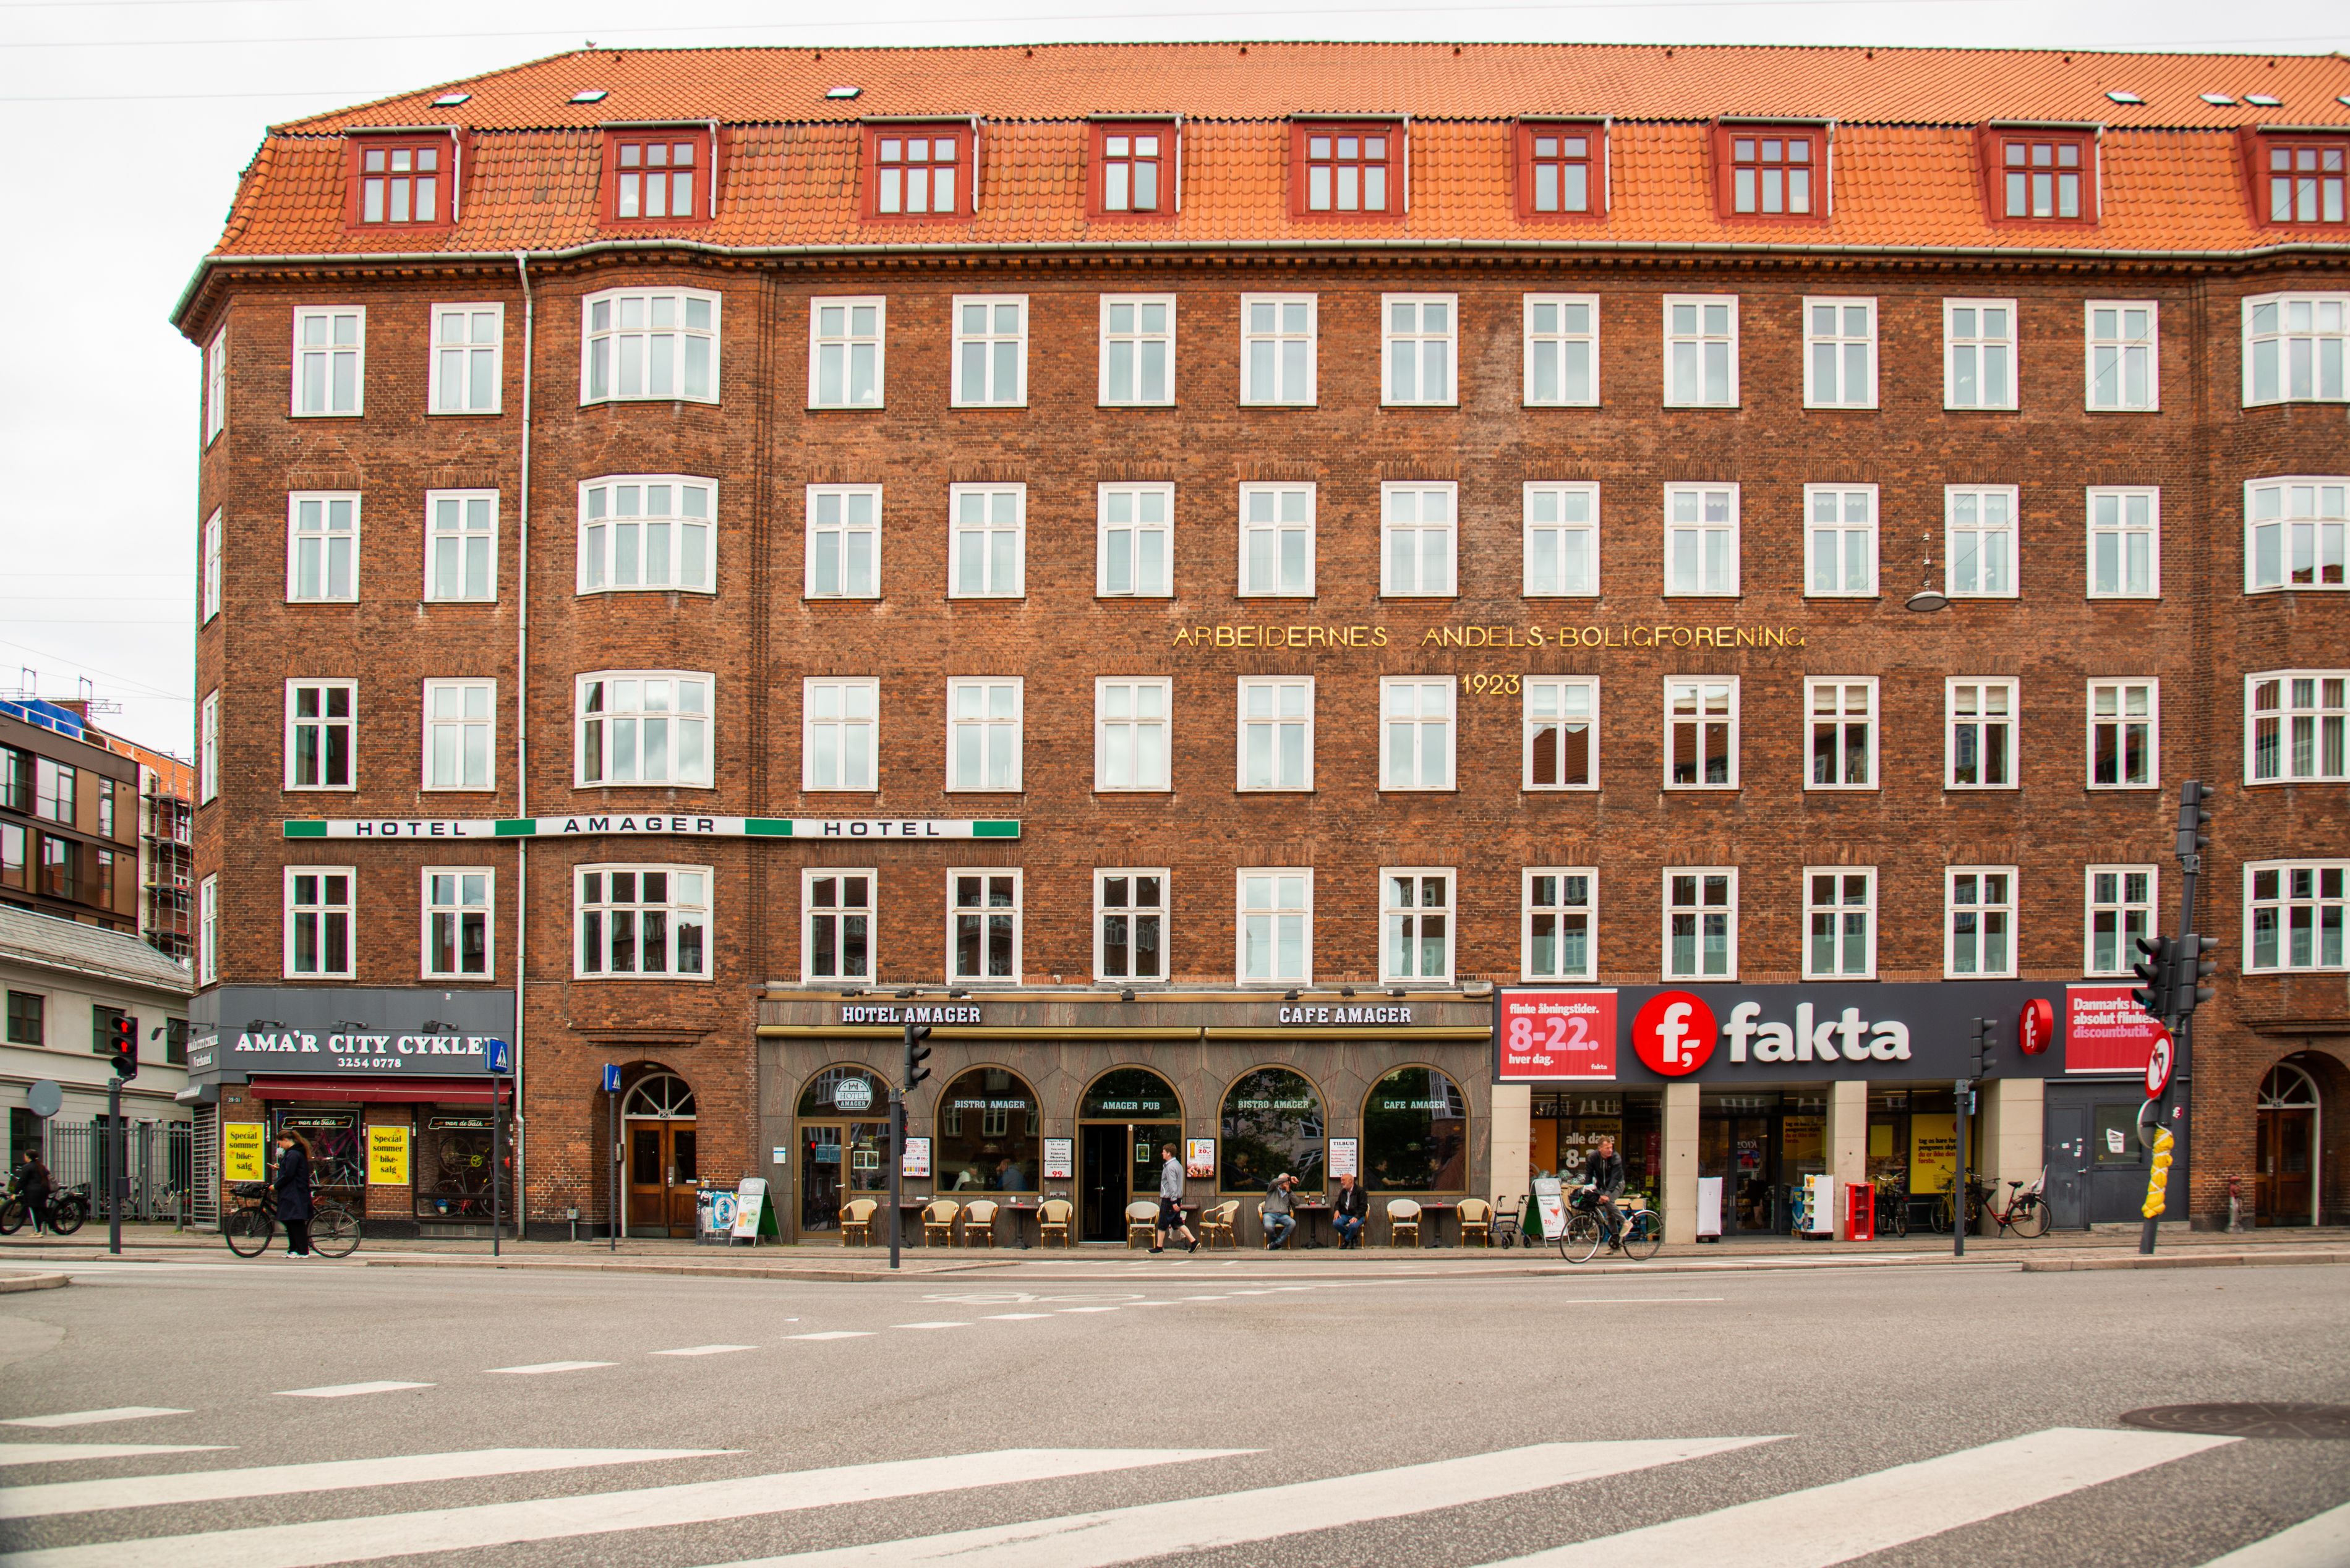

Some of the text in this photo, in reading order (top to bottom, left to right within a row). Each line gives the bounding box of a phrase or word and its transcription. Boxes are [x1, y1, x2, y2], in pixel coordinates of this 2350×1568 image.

[1173, 625, 1805, 647] ARBEIDERNES ANDELS-BOLIGFORENING
[1462, 674, 1520, 695] 1923
[356, 817, 939, 836] HOTEL AMAGER HOTEL
[1510, 1003, 1600, 1016] flinke åbningstider.
[2074, 997, 2130, 1010] Danmarks
[842, 1007, 981, 1023] HOTEL AMAGER
[1280, 1007, 1411, 1023] CAFE AMAGER
[2074, 1012, 2116, 1025] absolut
[1508, 1016, 1599, 1051] 8-22.
[1722, 1001, 1912, 1062] fakta
[2074, 1025, 2153, 1038] discountbutik.
[329, 1034, 390, 1054] CITY
[397, 1036, 500, 1055] CYKLE
[338, 1058, 402, 1068] 3254 0778
[1508, 1054, 1554, 1066] hver dag.
[955, 1100, 1025, 1109] BISTRO AMAGER
[1103, 1101, 1160, 1110] AMAGER PUB
[1238, 1100, 1309, 1109] BISTRO AMAGER
[1384, 1101, 1446, 1109] CAFE AMAGER
[230, 1131, 257, 1141] Special
[374, 1134, 402, 1144] Special
[1566, 1132, 1615, 1144] alle dae
[236, 1152, 254, 1160] bike-
[380, 1155, 398, 1163] bike-
[236, 1162, 253, 1171] salg
[380, 1166, 397, 1174] salg
